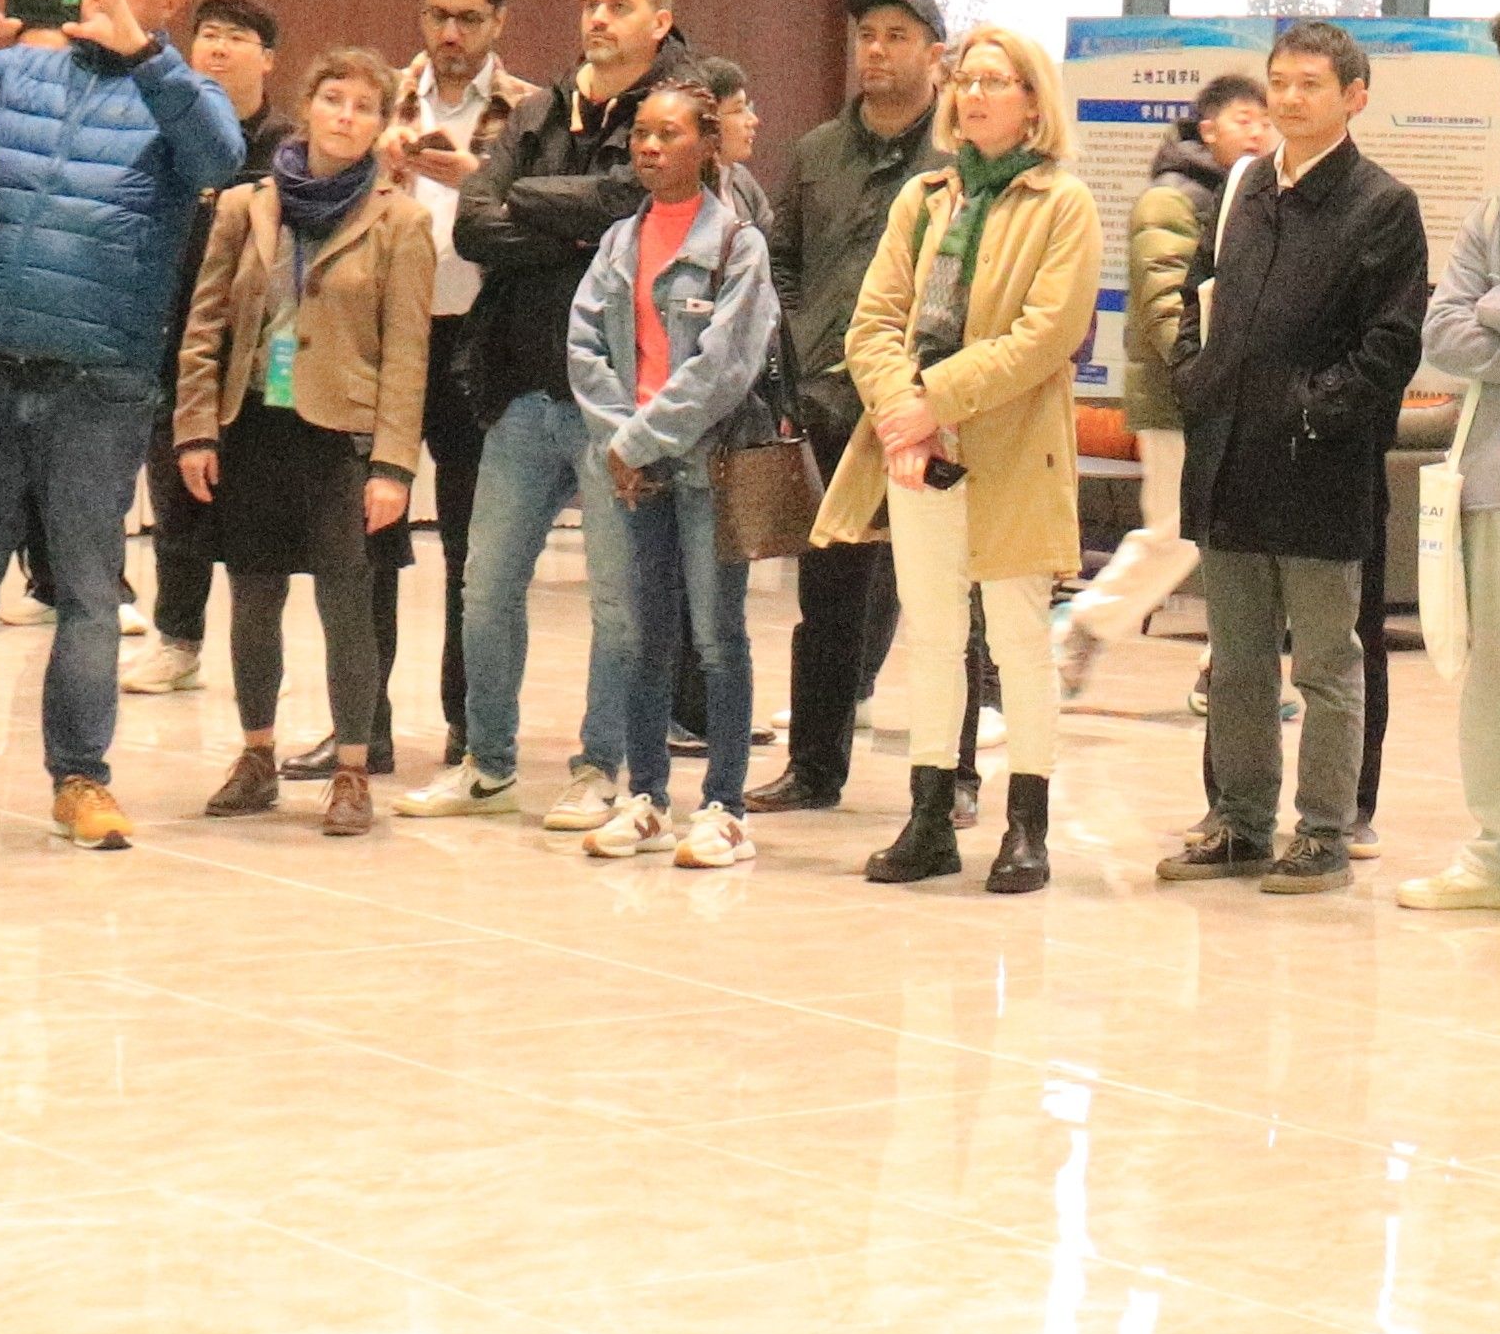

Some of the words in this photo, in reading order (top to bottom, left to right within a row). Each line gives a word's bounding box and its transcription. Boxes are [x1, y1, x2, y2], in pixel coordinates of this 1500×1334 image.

[1132, 69, 1200, 85] 土地工程学科
